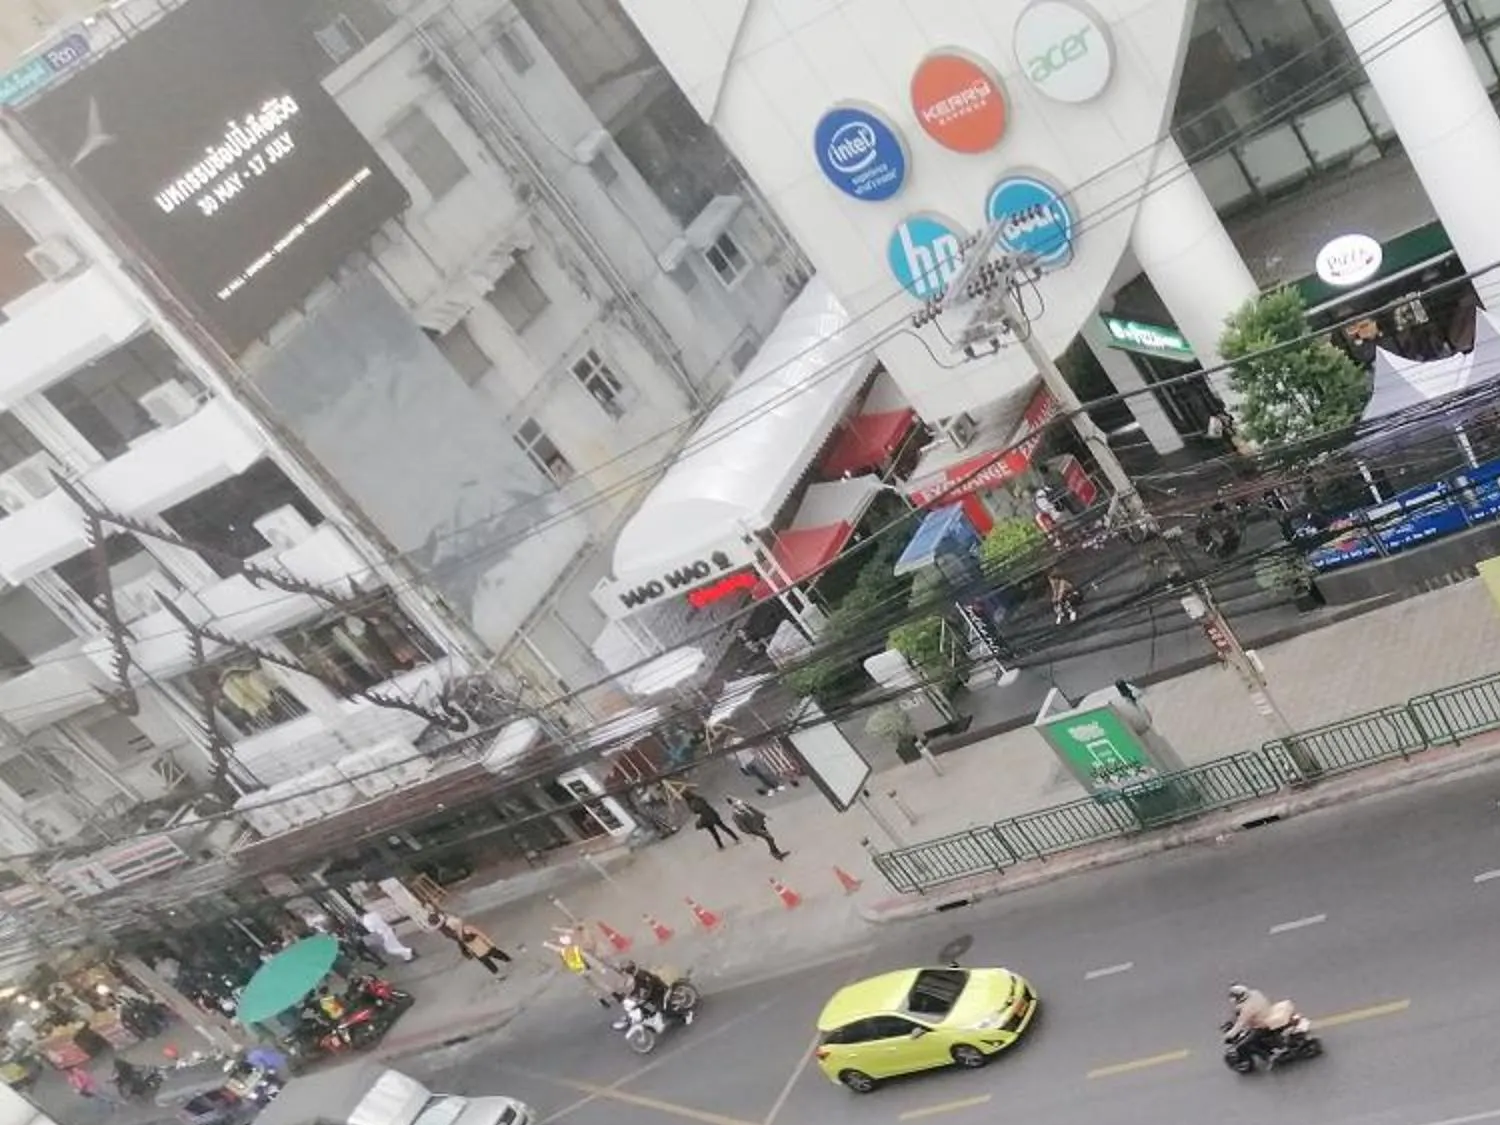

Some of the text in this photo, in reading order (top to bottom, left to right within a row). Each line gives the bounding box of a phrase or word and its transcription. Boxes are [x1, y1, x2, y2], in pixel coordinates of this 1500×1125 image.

[1028, 24, 1090, 83] acer
[922, 79, 991, 122] KERRY
[831, 126, 874, 163] intel
[197, 194, 219, 216] 30
[214, 172, 245, 204] MAY
[248, 154, 267, 176] 17
[264, 131, 295, 164] JULY
